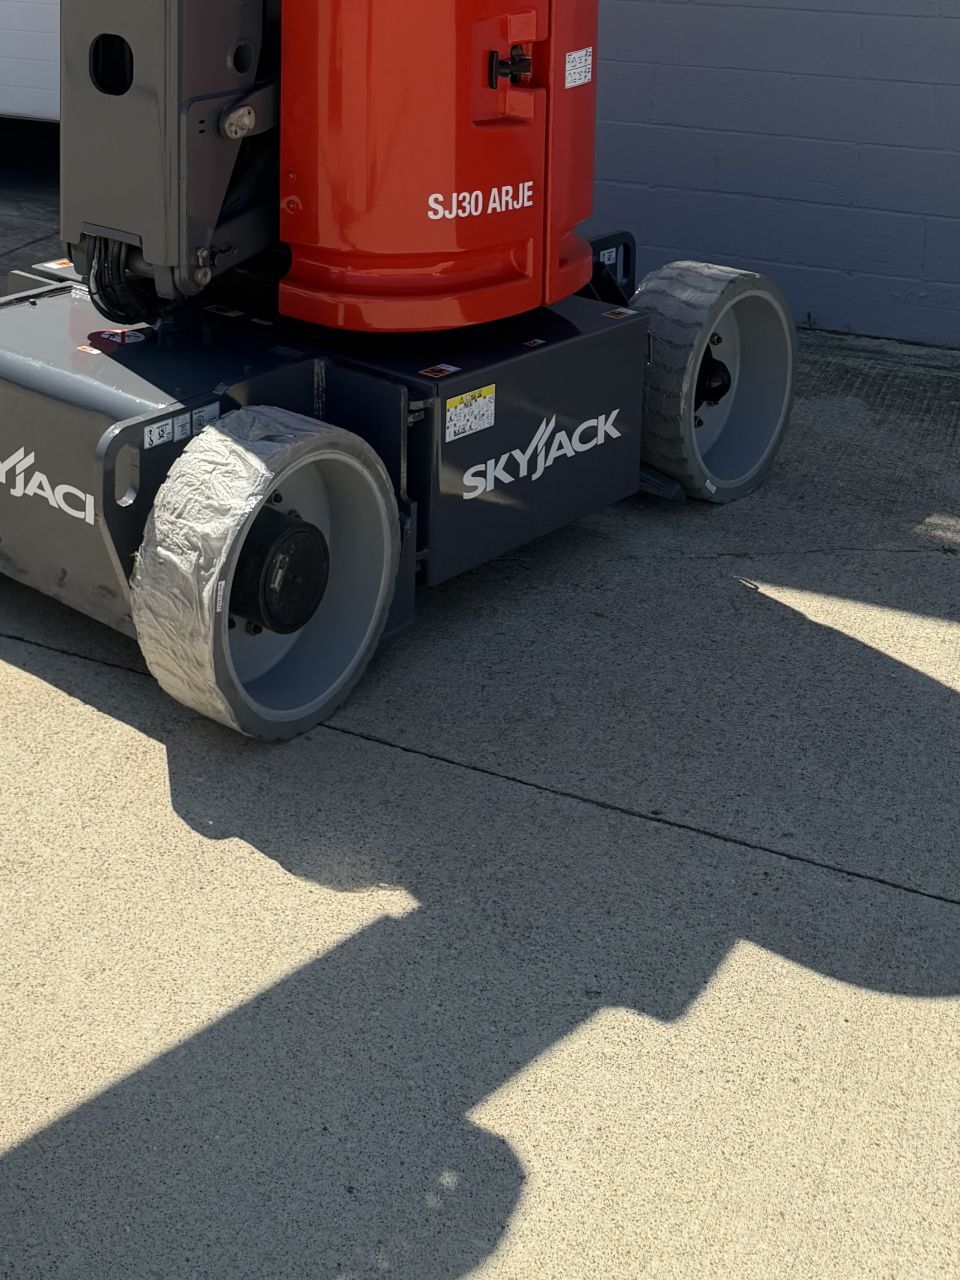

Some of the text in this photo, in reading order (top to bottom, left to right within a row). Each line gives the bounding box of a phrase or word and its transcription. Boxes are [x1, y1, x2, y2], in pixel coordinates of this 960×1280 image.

[427, 181, 534, 220] SJ30 ARJE
[462, 408, 622, 500] SKYJACK
